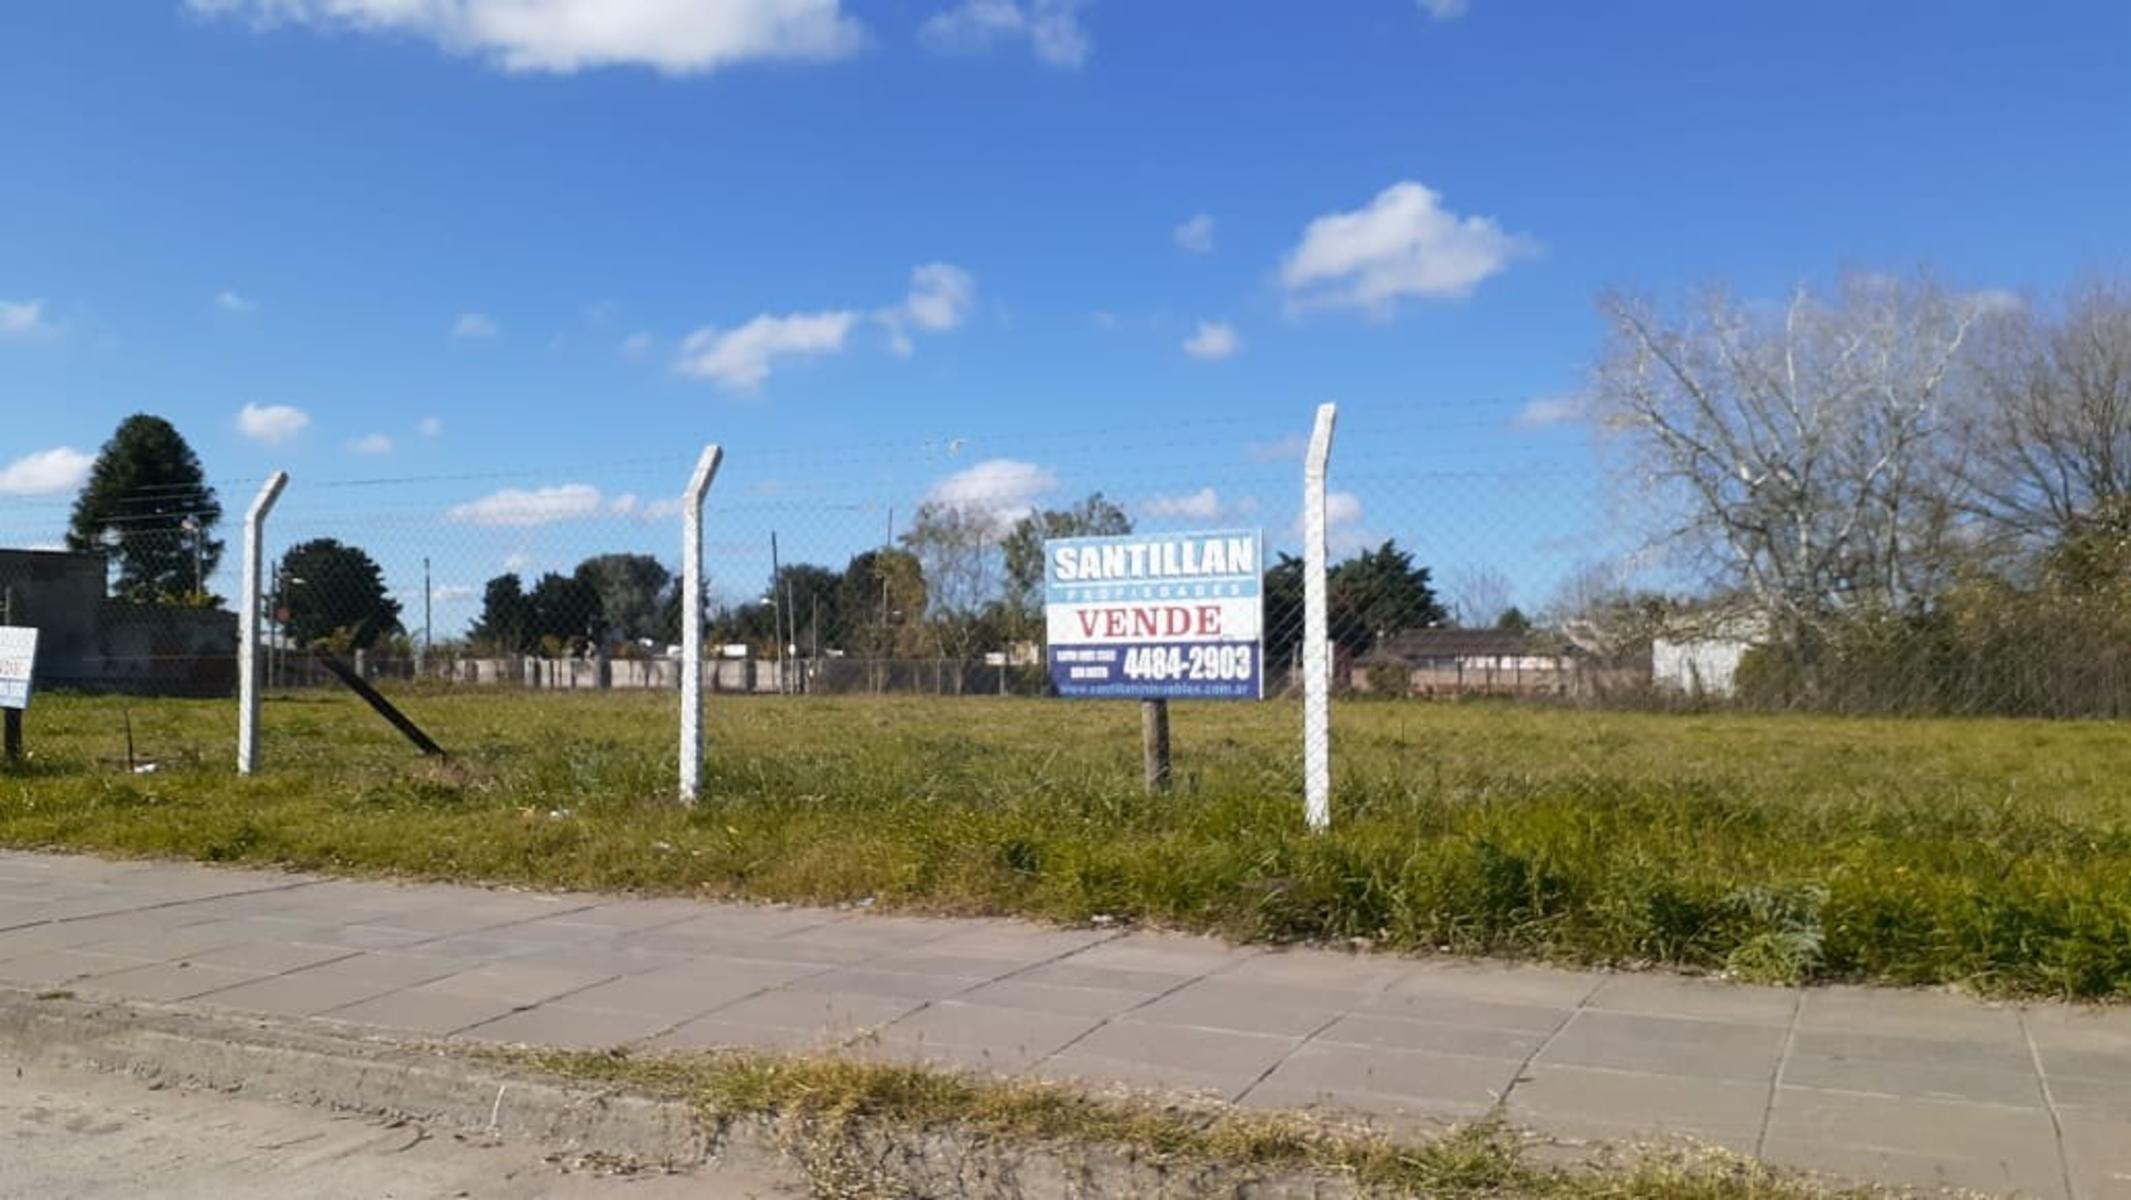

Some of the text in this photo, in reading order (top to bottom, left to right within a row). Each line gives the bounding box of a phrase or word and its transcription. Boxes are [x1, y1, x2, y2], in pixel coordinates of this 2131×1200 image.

[1055, 538, 1254, 580] SANTILLAN
[1077, 605, 1222, 637] VENDE
[1123, 645, 1251, 680] 4484-2903
